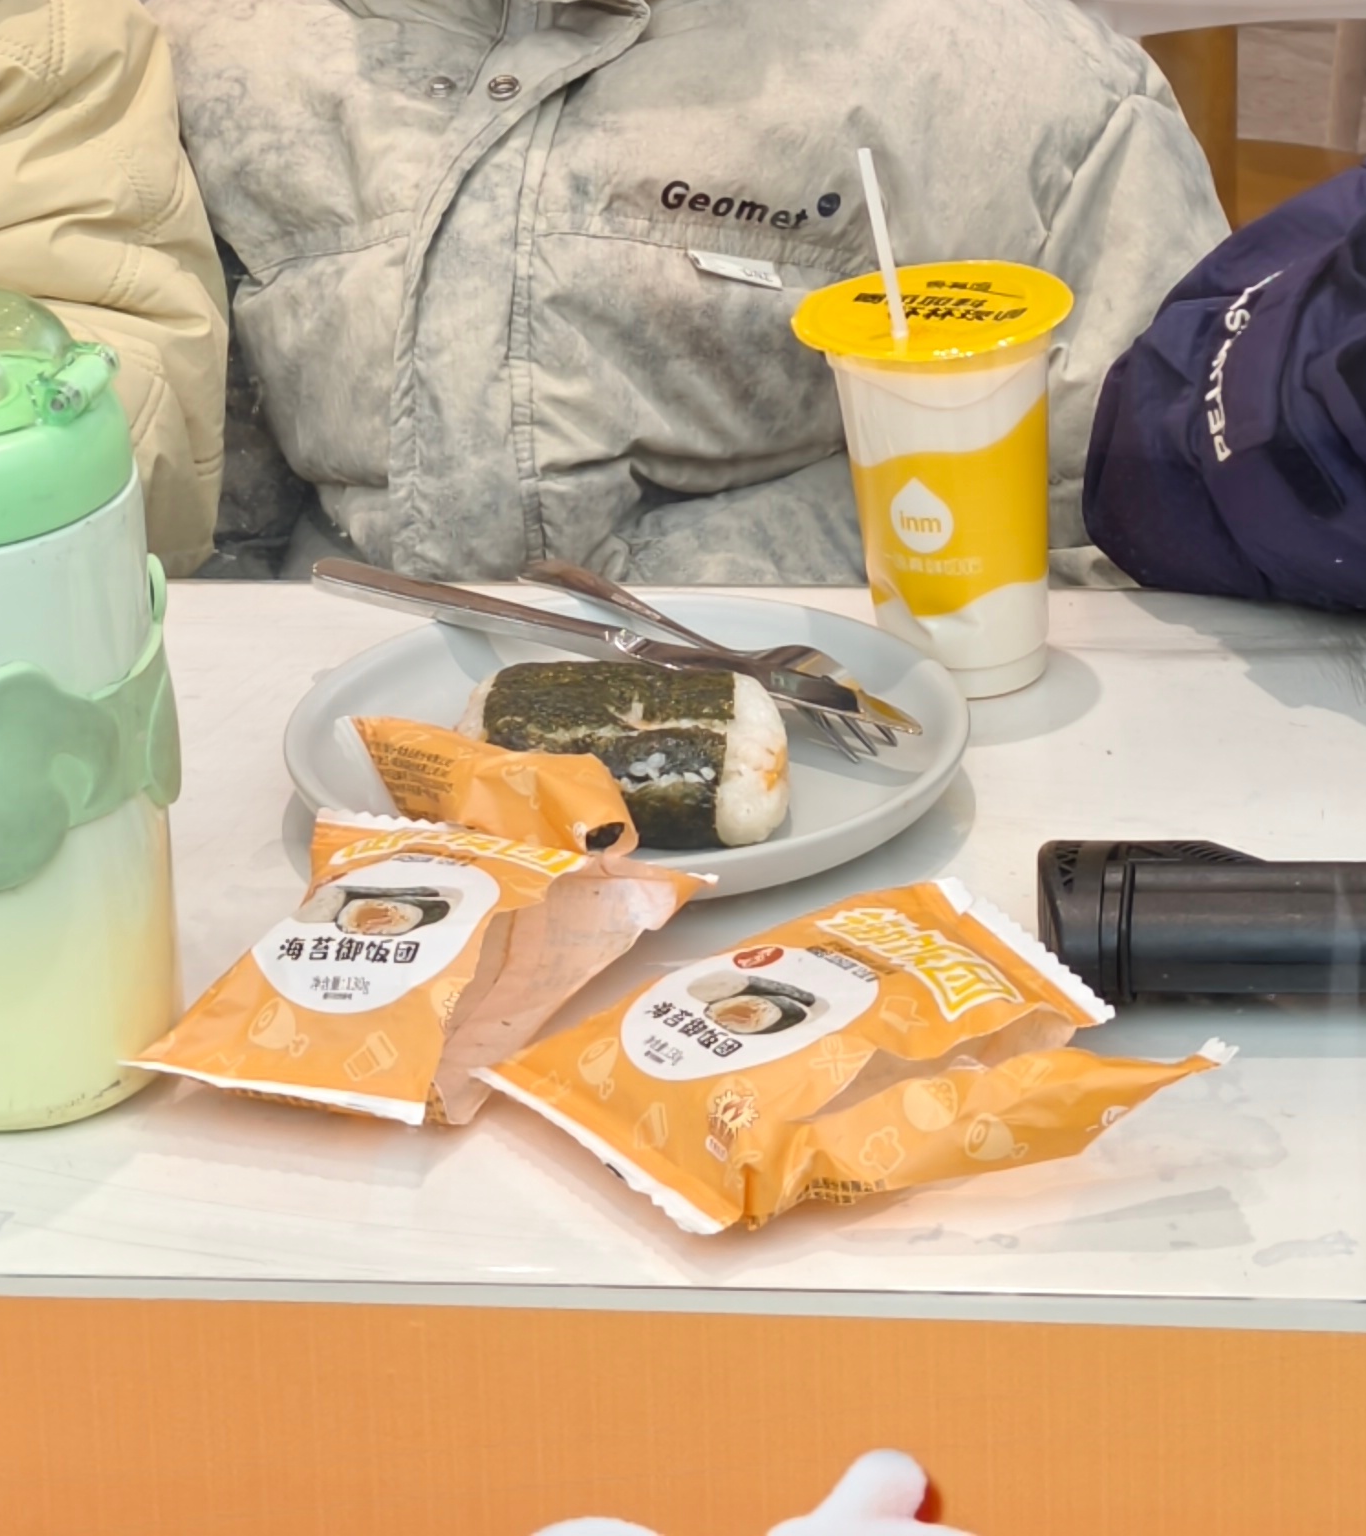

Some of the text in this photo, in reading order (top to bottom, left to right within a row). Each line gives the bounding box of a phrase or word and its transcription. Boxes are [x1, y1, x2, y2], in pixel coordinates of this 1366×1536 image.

[899, 510, 942, 533] inm
[277, 936, 421, 964] 海苔御饭团
[644, 1000, 744, 1058] 海苔御饭团
